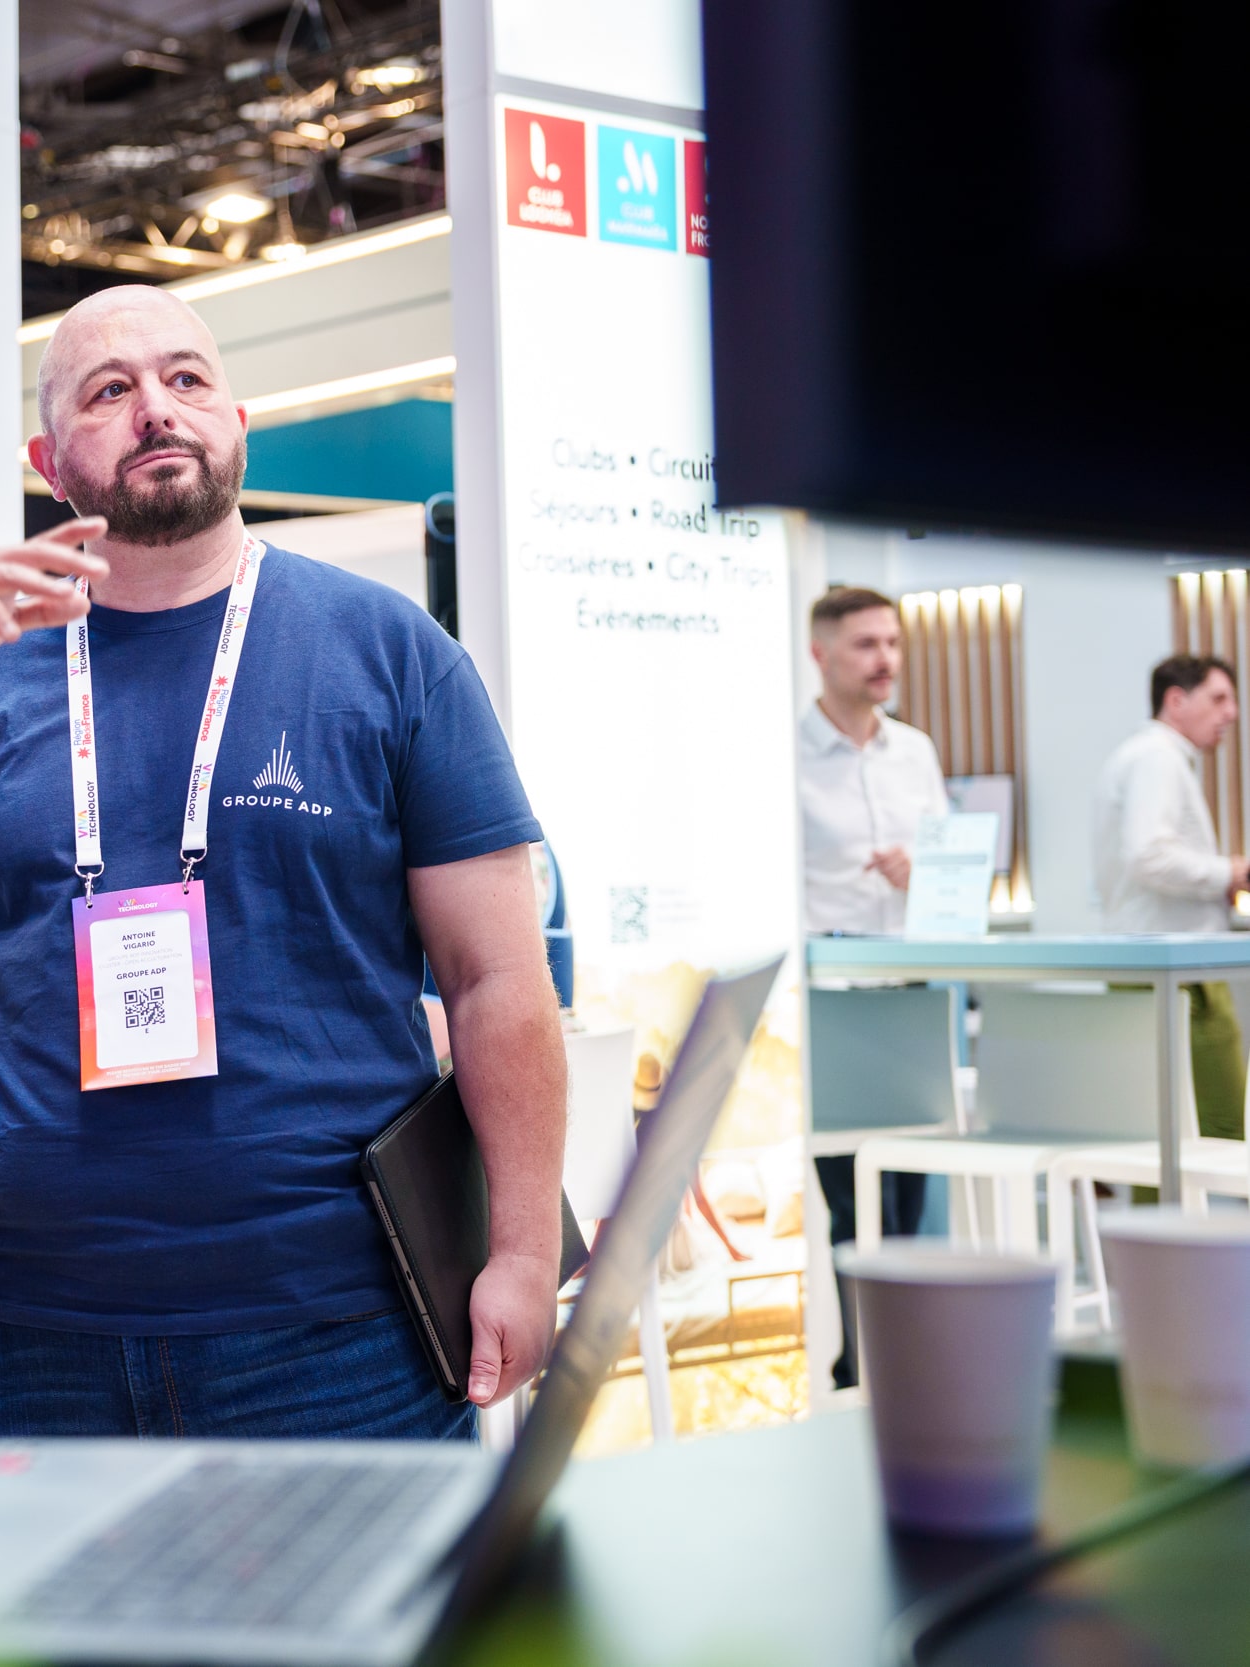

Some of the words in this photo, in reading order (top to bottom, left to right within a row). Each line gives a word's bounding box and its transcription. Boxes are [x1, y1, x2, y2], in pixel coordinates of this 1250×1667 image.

[552, 436, 617, 471] Clubs
[649, 447, 713, 482] Circui
[530, 489, 619, 529] Séjours
[650, 498, 708, 534] Road
[519, 542, 636, 577] Croisières
[665, 552, 710, 590] City
[720, 556, 773, 588] Trips
[220, 604, 238, 655] TECHNOLOGY
[234, 606, 249, 629] VIVA
[70, 651, 80, 677] VIVA
[78, 625, 88, 675] TECHNOLOGY
[216, 689, 229, 717] Région
[73, 718, 84, 746] Région
[199, 763, 213, 791] VIVA
[187, 763, 202, 822] TECHNOLOGY
[222, 795, 294, 810] GROUPE
[297, 800, 334, 817] ADP
[86, 780, 98, 839] TECHNOLOGY
[77, 810, 89, 839] VIVA
[118, 902, 158, 913] TECHNOLOGY
[122, 931, 156, 941] ANTOINE
[123, 940, 156, 950] VIGARIO
[116, 970, 149, 980] GROUPE
[150, 967, 167, 976] ADP
